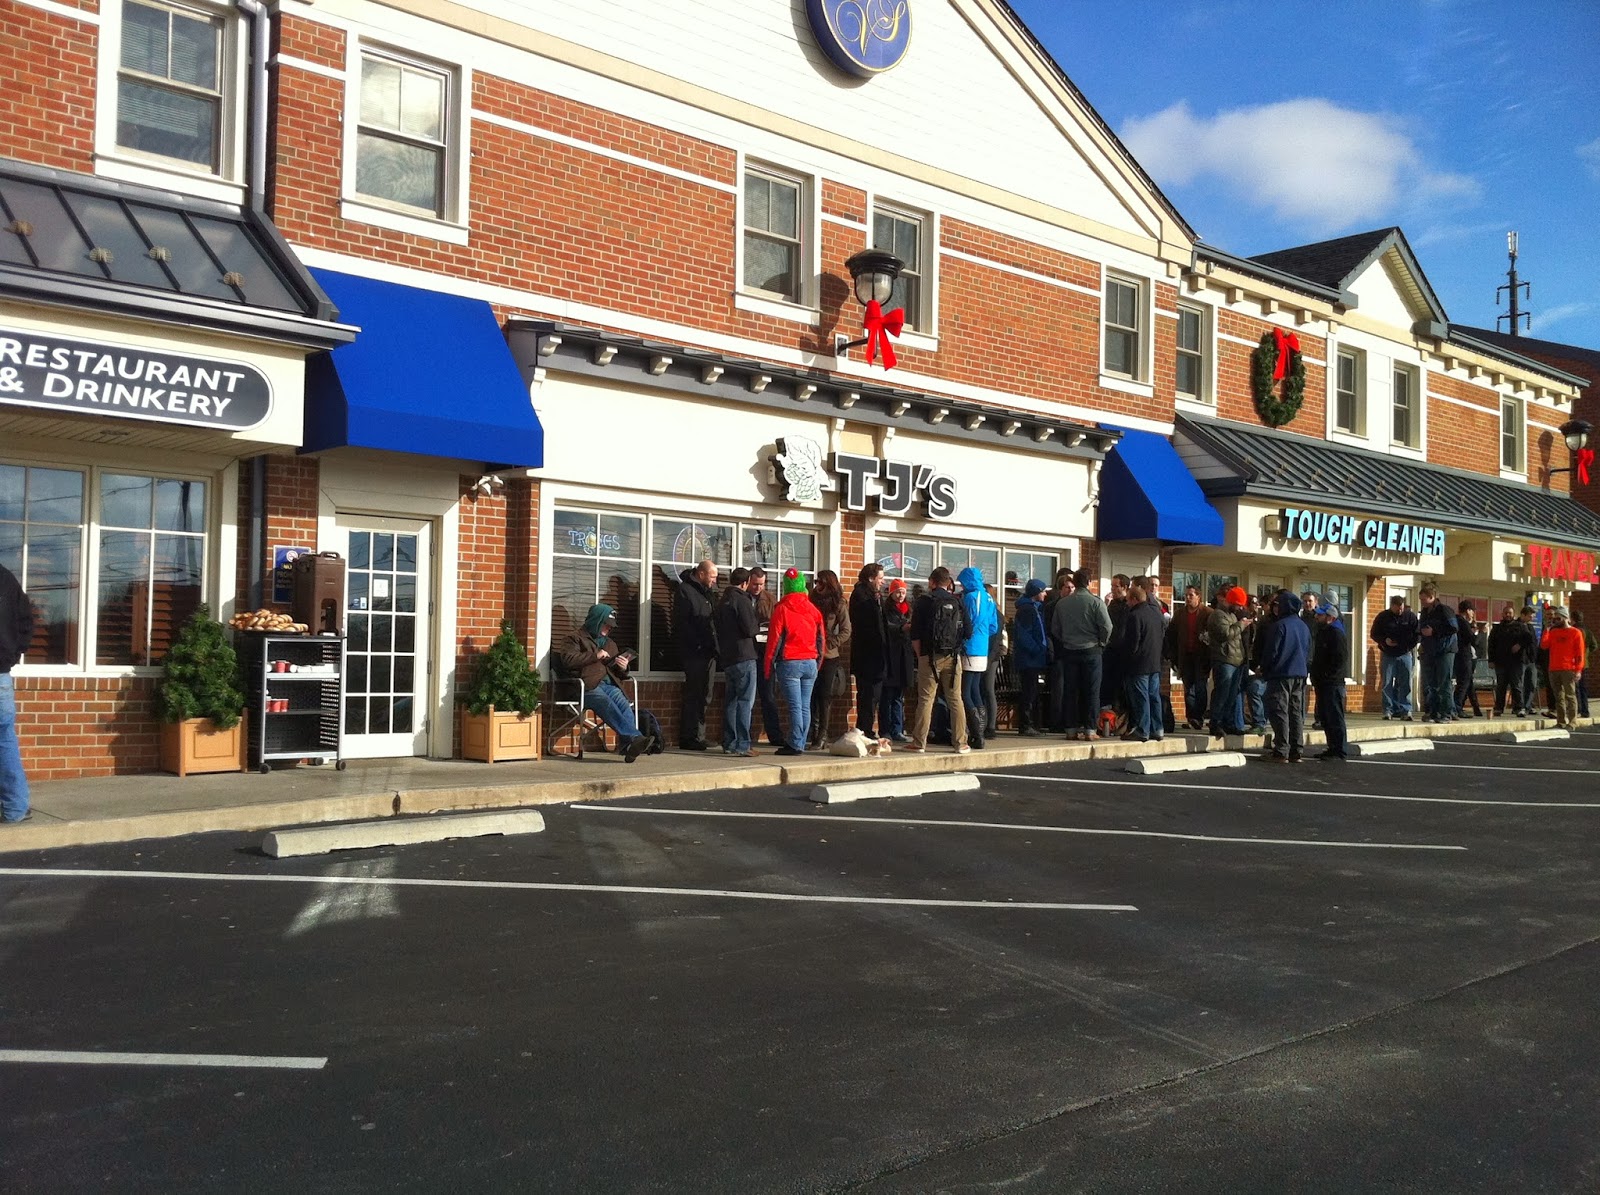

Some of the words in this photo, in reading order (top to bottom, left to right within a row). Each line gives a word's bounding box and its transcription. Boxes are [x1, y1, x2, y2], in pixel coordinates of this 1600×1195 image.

[0, 338, 245, 393] RESTAURANT
[0, 366, 25, 394] &
[42, 372, 232, 418] DRINKERY
[835, 452, 957, 520] TJ'S
[1284, 507, 1355, 546] TOUCH
[1363, 519, 1446, 556] CLEANER
[1527, 543, 1600, 585] TRAVEL
